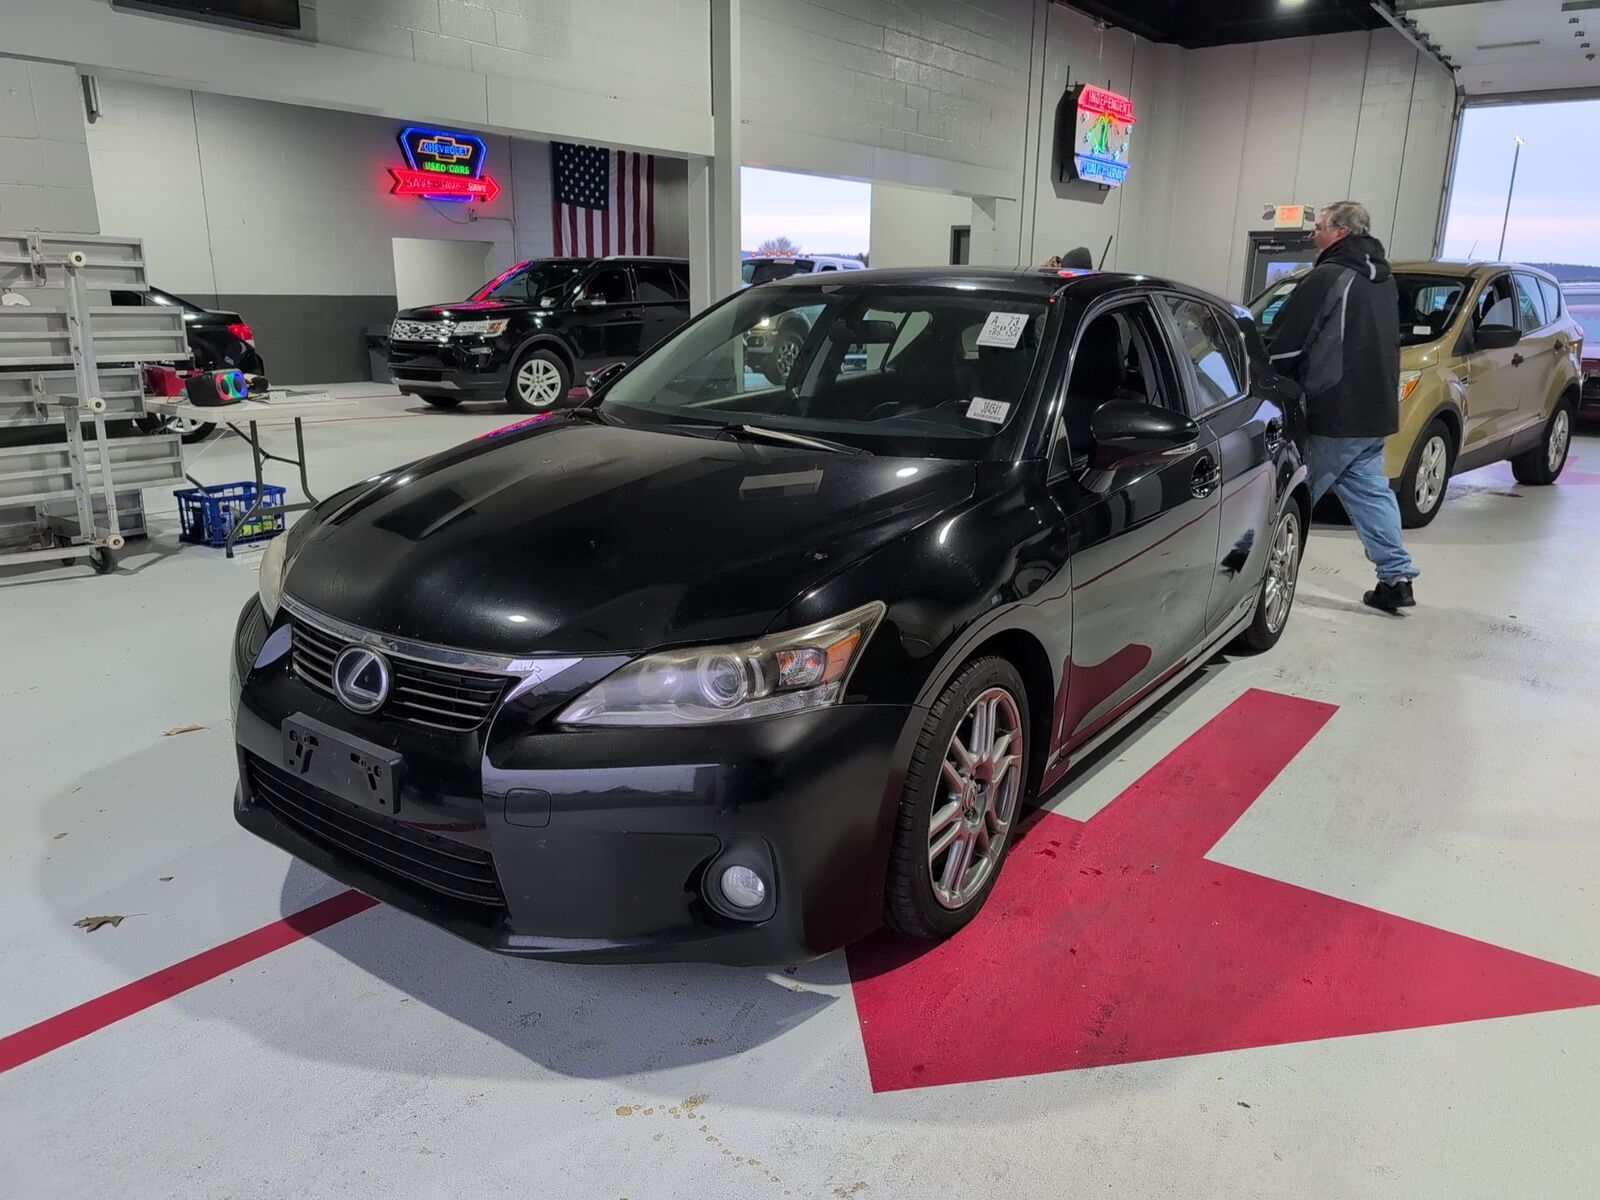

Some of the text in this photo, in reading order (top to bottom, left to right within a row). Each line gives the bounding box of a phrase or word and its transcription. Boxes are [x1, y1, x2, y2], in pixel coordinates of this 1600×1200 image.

[1087, 89, 1132, 115] INDEPENDENT
[423, 142, 467, 155] CHEVROLET
[423, 161, 470, 175] USED CARS
[467, 182, 488, 193] SAVE
[991, 315, 1020, 326] A 73
